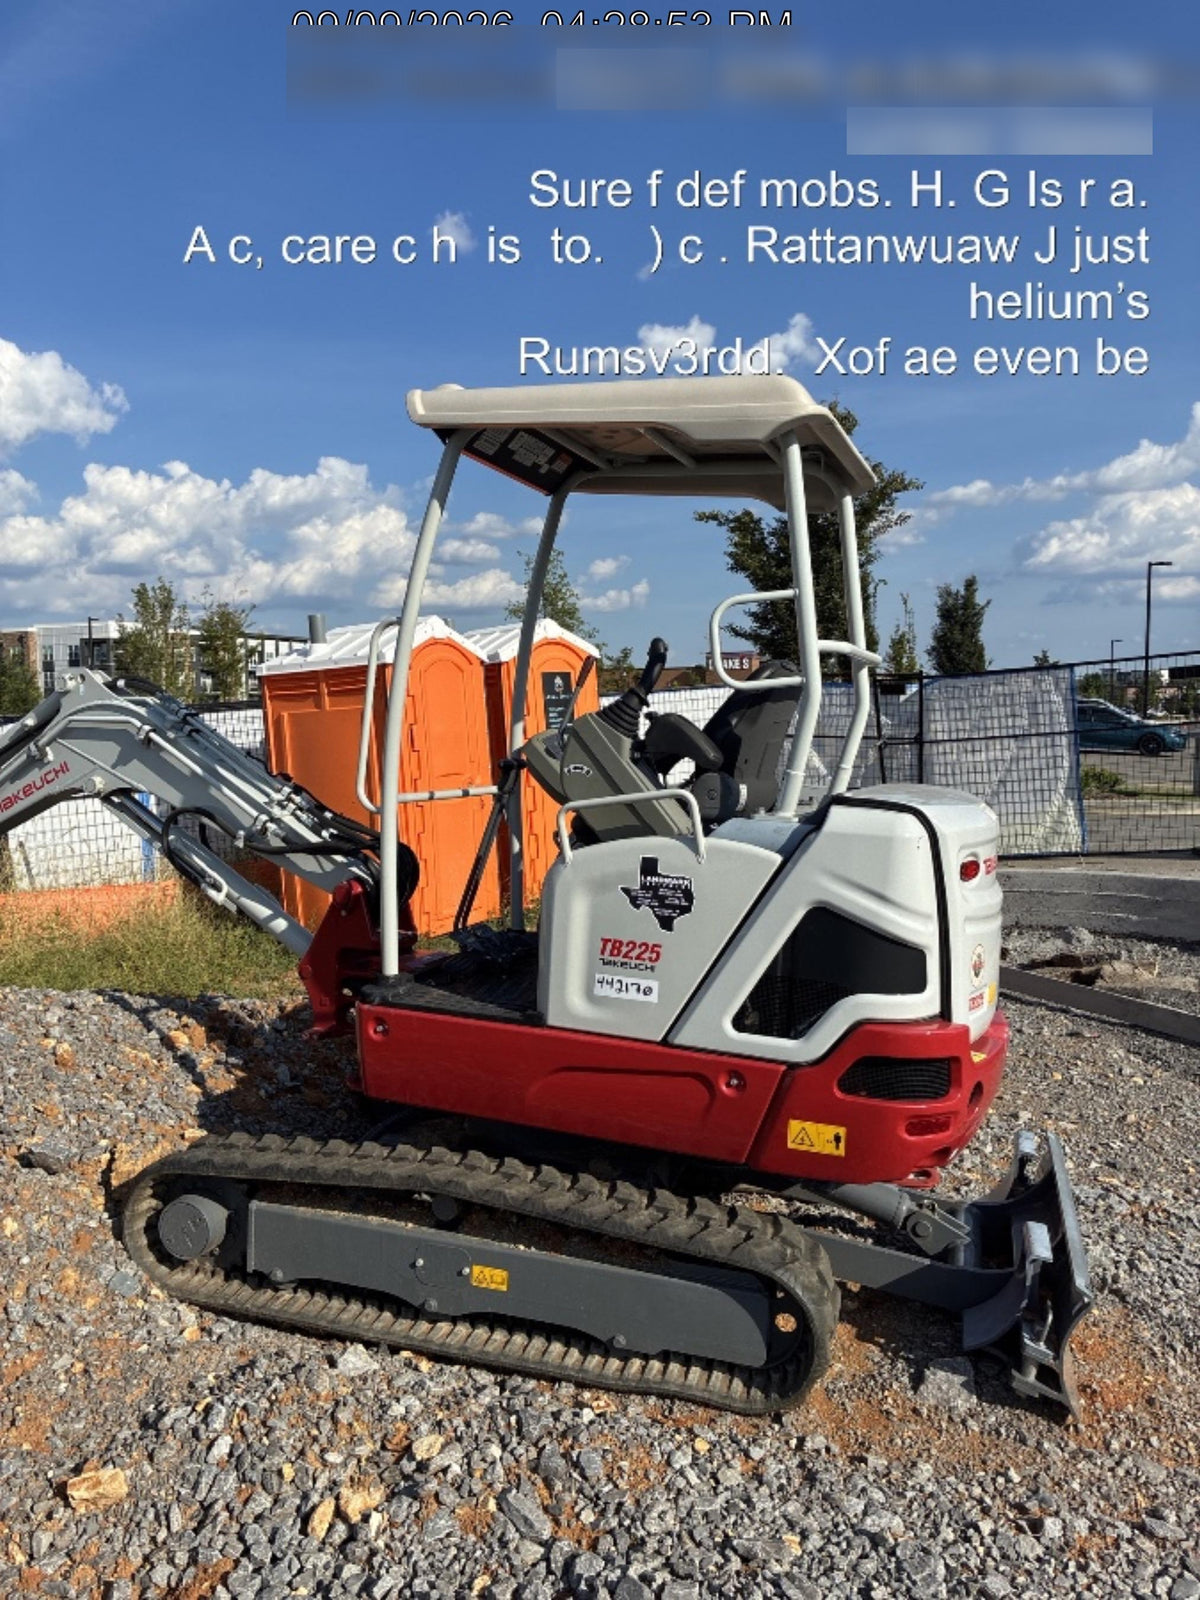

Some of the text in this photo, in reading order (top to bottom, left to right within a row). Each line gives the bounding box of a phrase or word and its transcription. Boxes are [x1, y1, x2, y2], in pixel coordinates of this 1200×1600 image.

[600, 937, 662, 963] TB225
[599, 957, 656, 973] TAKEUCHI
[597, 975, 653, 997] 442170
